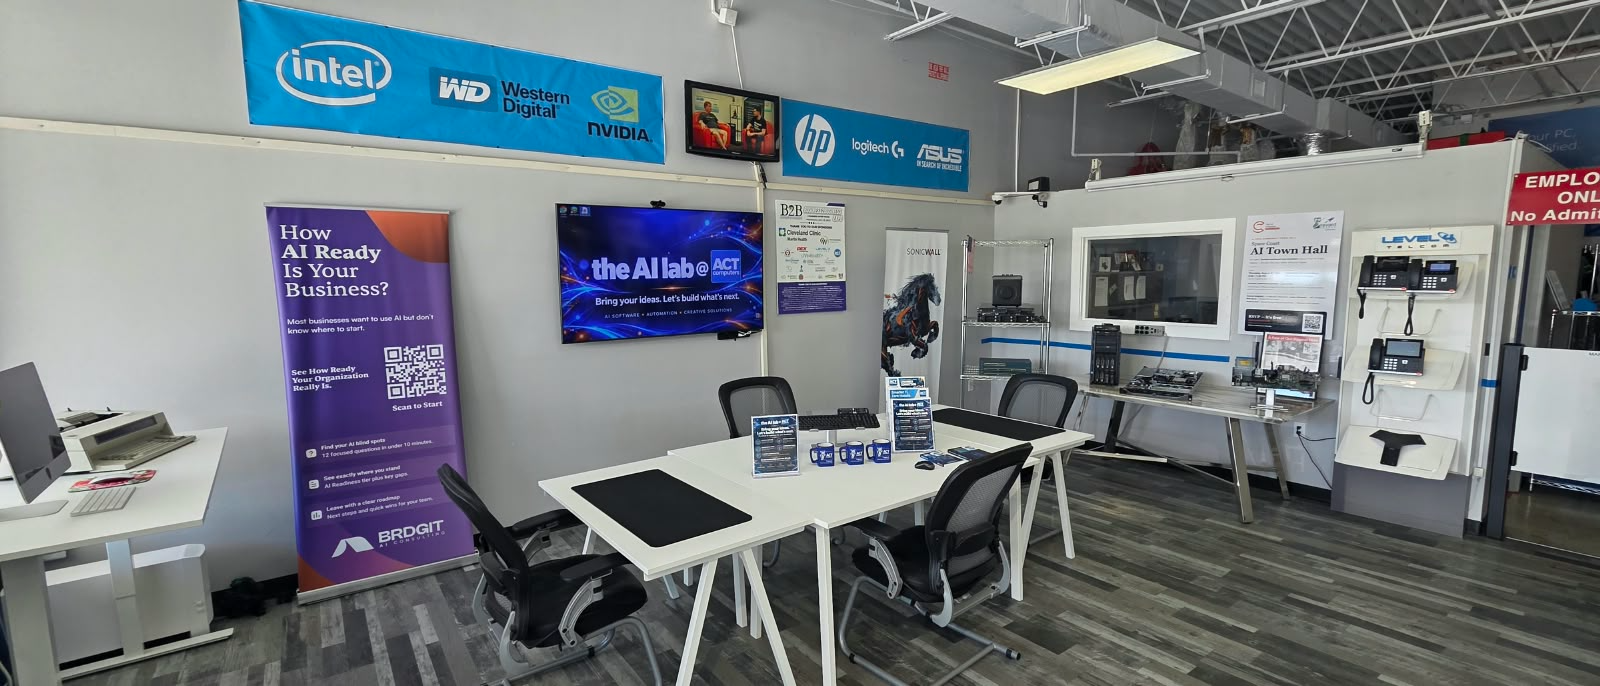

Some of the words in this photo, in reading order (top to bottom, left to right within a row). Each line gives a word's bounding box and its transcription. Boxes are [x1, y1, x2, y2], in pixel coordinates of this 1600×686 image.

[291, 49, 375, 89] intel
[440, 76, 491, 103] WD
[502, 80, 570, 105] Western
[503, 98, 556, 119] Digital
[800, 114, 831, 166] hp
[852, 138, 890, 155] logitech
[917, 144, 962, 164] ASUS
[781, 204, 802, 216] B2B
[1511, 211, 1536, 221] No
[280, 224, 332, 240] How
[1382, 235, 1440, 243] LEVEL
[281, 245, 308, 259] AI
[314, 245, 381, 263] Ready
[1302, 245, 1328, 254] Hall
[284, 264, 302, 278] Is
[308, 264, 359, 278] Your
[592, 257, 630, 280] the
[632, 257, 658, 280] AI
[662, 257, 694, 279] lab
[696, 262, 709, 276] @
[712, 258, 740, 271] ACT
[285, 282, 389, 297] Business?
[596, 297, 618, 306] Bring
[619, 297, 637, 306] your
[640, 296, 661, 304] ideas.
[663, 295, 680, 303] Let's
[315, 372, 369, 382] Organization
[293, 383, 320, 392] Really
[378, 520, 444, 543] BRDGIT
[394, 531, 445, 545] CONSULTING
